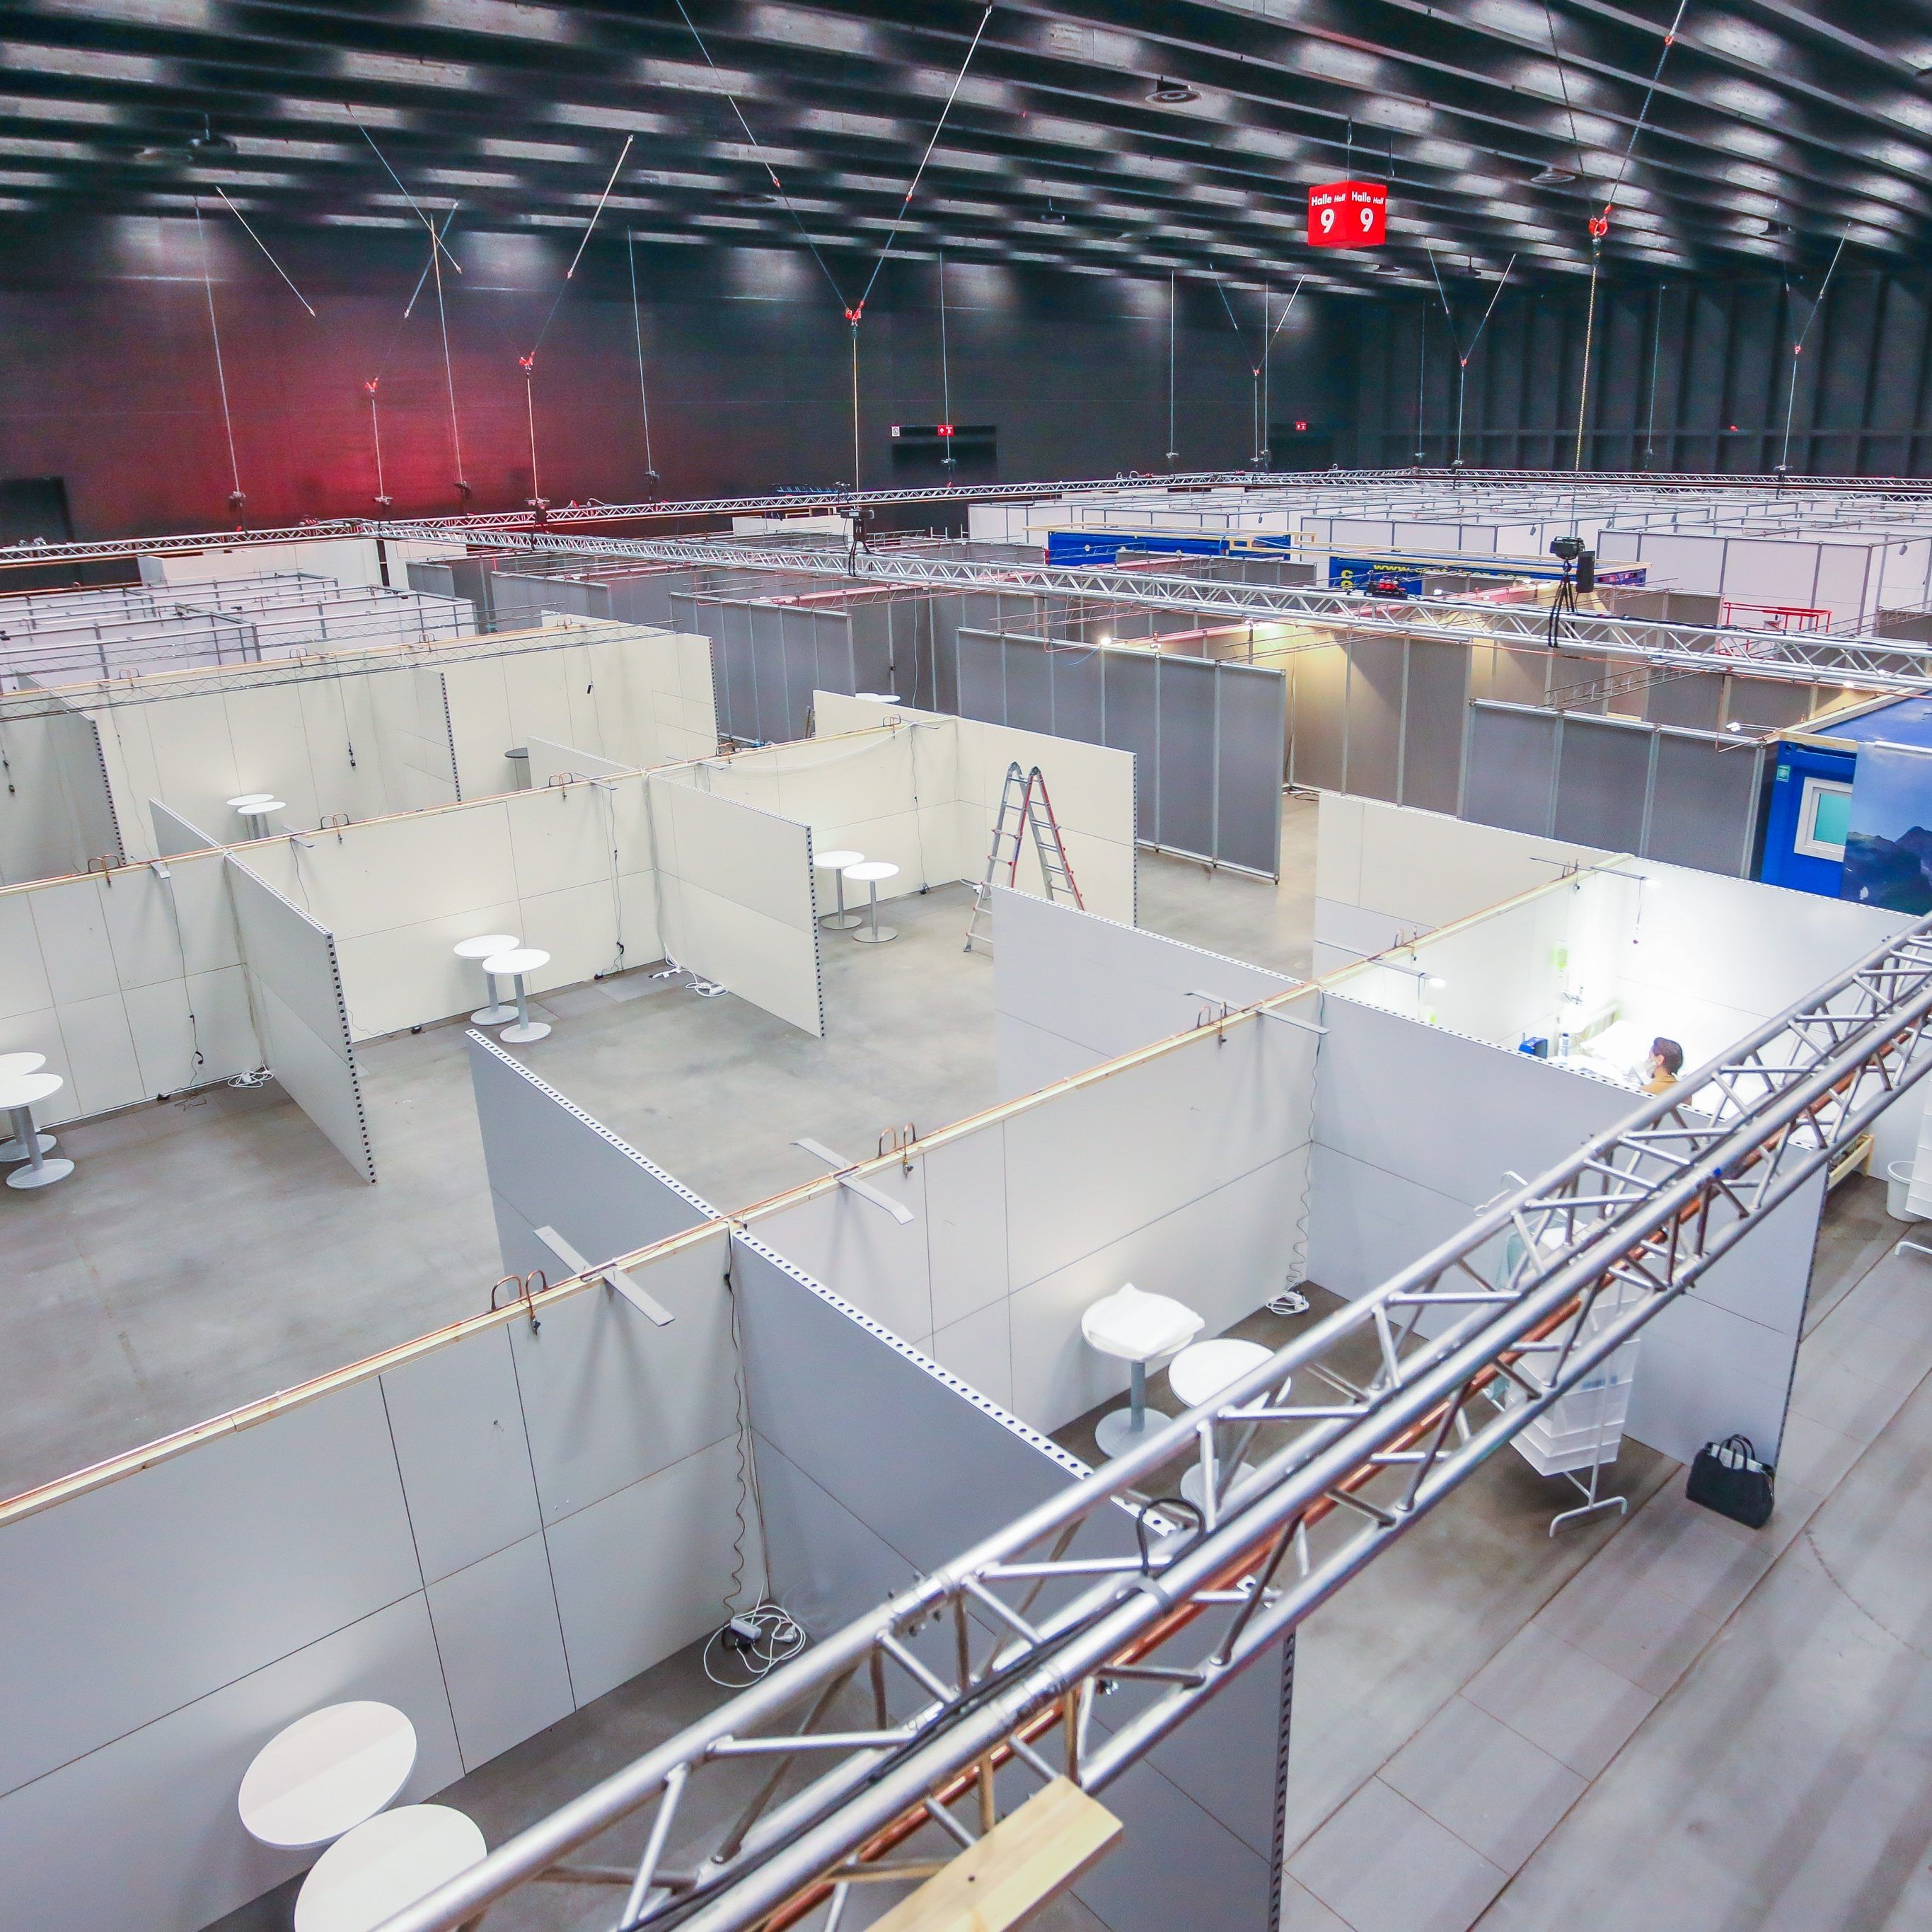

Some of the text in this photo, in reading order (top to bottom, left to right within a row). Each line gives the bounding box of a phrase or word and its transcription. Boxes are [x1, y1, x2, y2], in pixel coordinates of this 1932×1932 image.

[1311, 194, 1346, 206] Halle Hall
[1351, 191, 1371, 203] Halle
[1321, 209, 1334, 233] 9
[1360, 208, 1373, 232] 9
